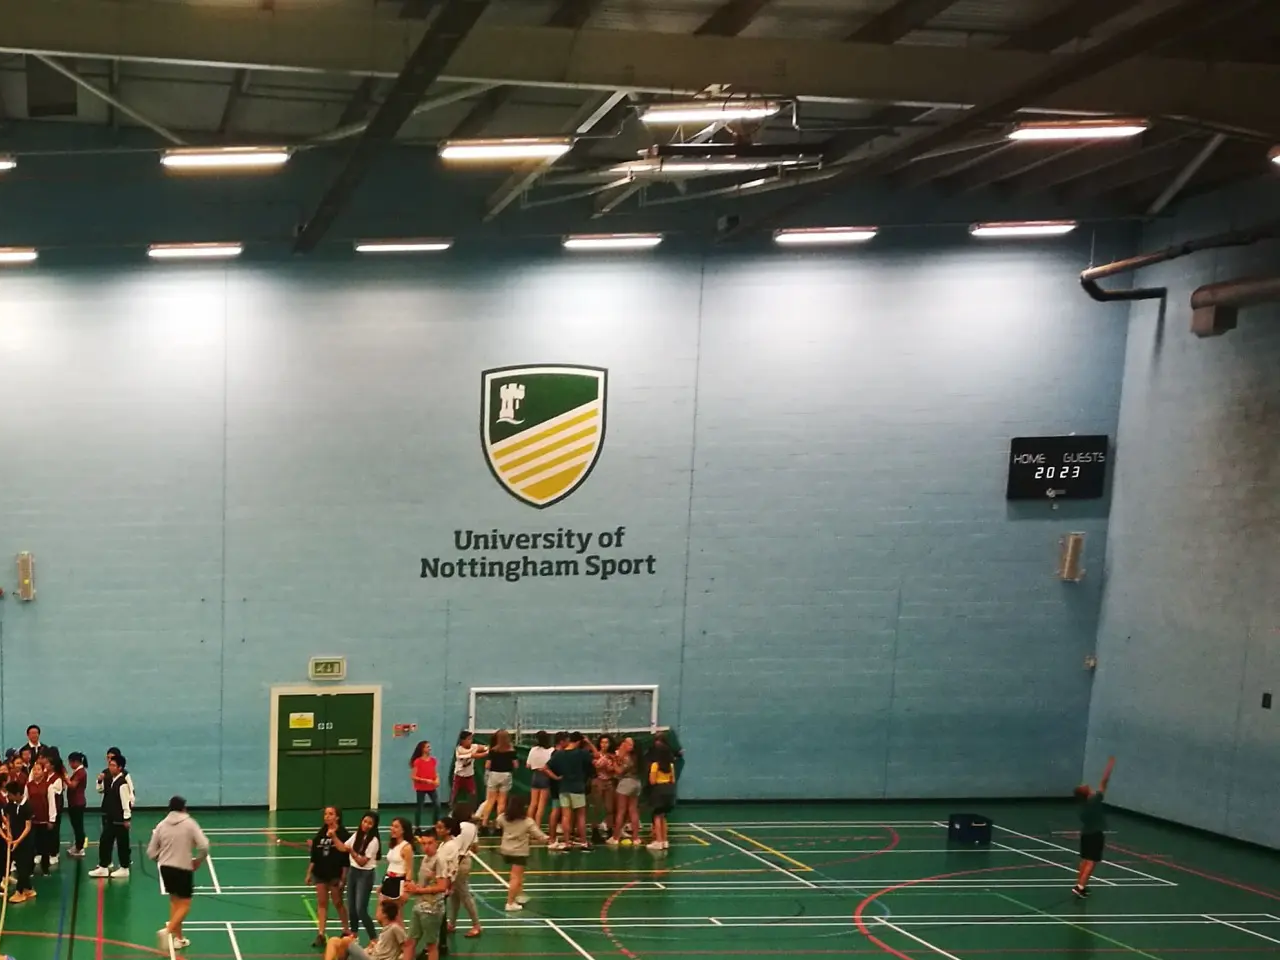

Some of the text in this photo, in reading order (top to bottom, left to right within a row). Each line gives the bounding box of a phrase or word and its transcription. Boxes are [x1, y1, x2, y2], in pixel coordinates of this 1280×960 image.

[1014, 452, 1105, 464] HOME GUESTS
[454, 526, 626, 554] University of
[420, 554, 656, 582] Nottingham Sport
